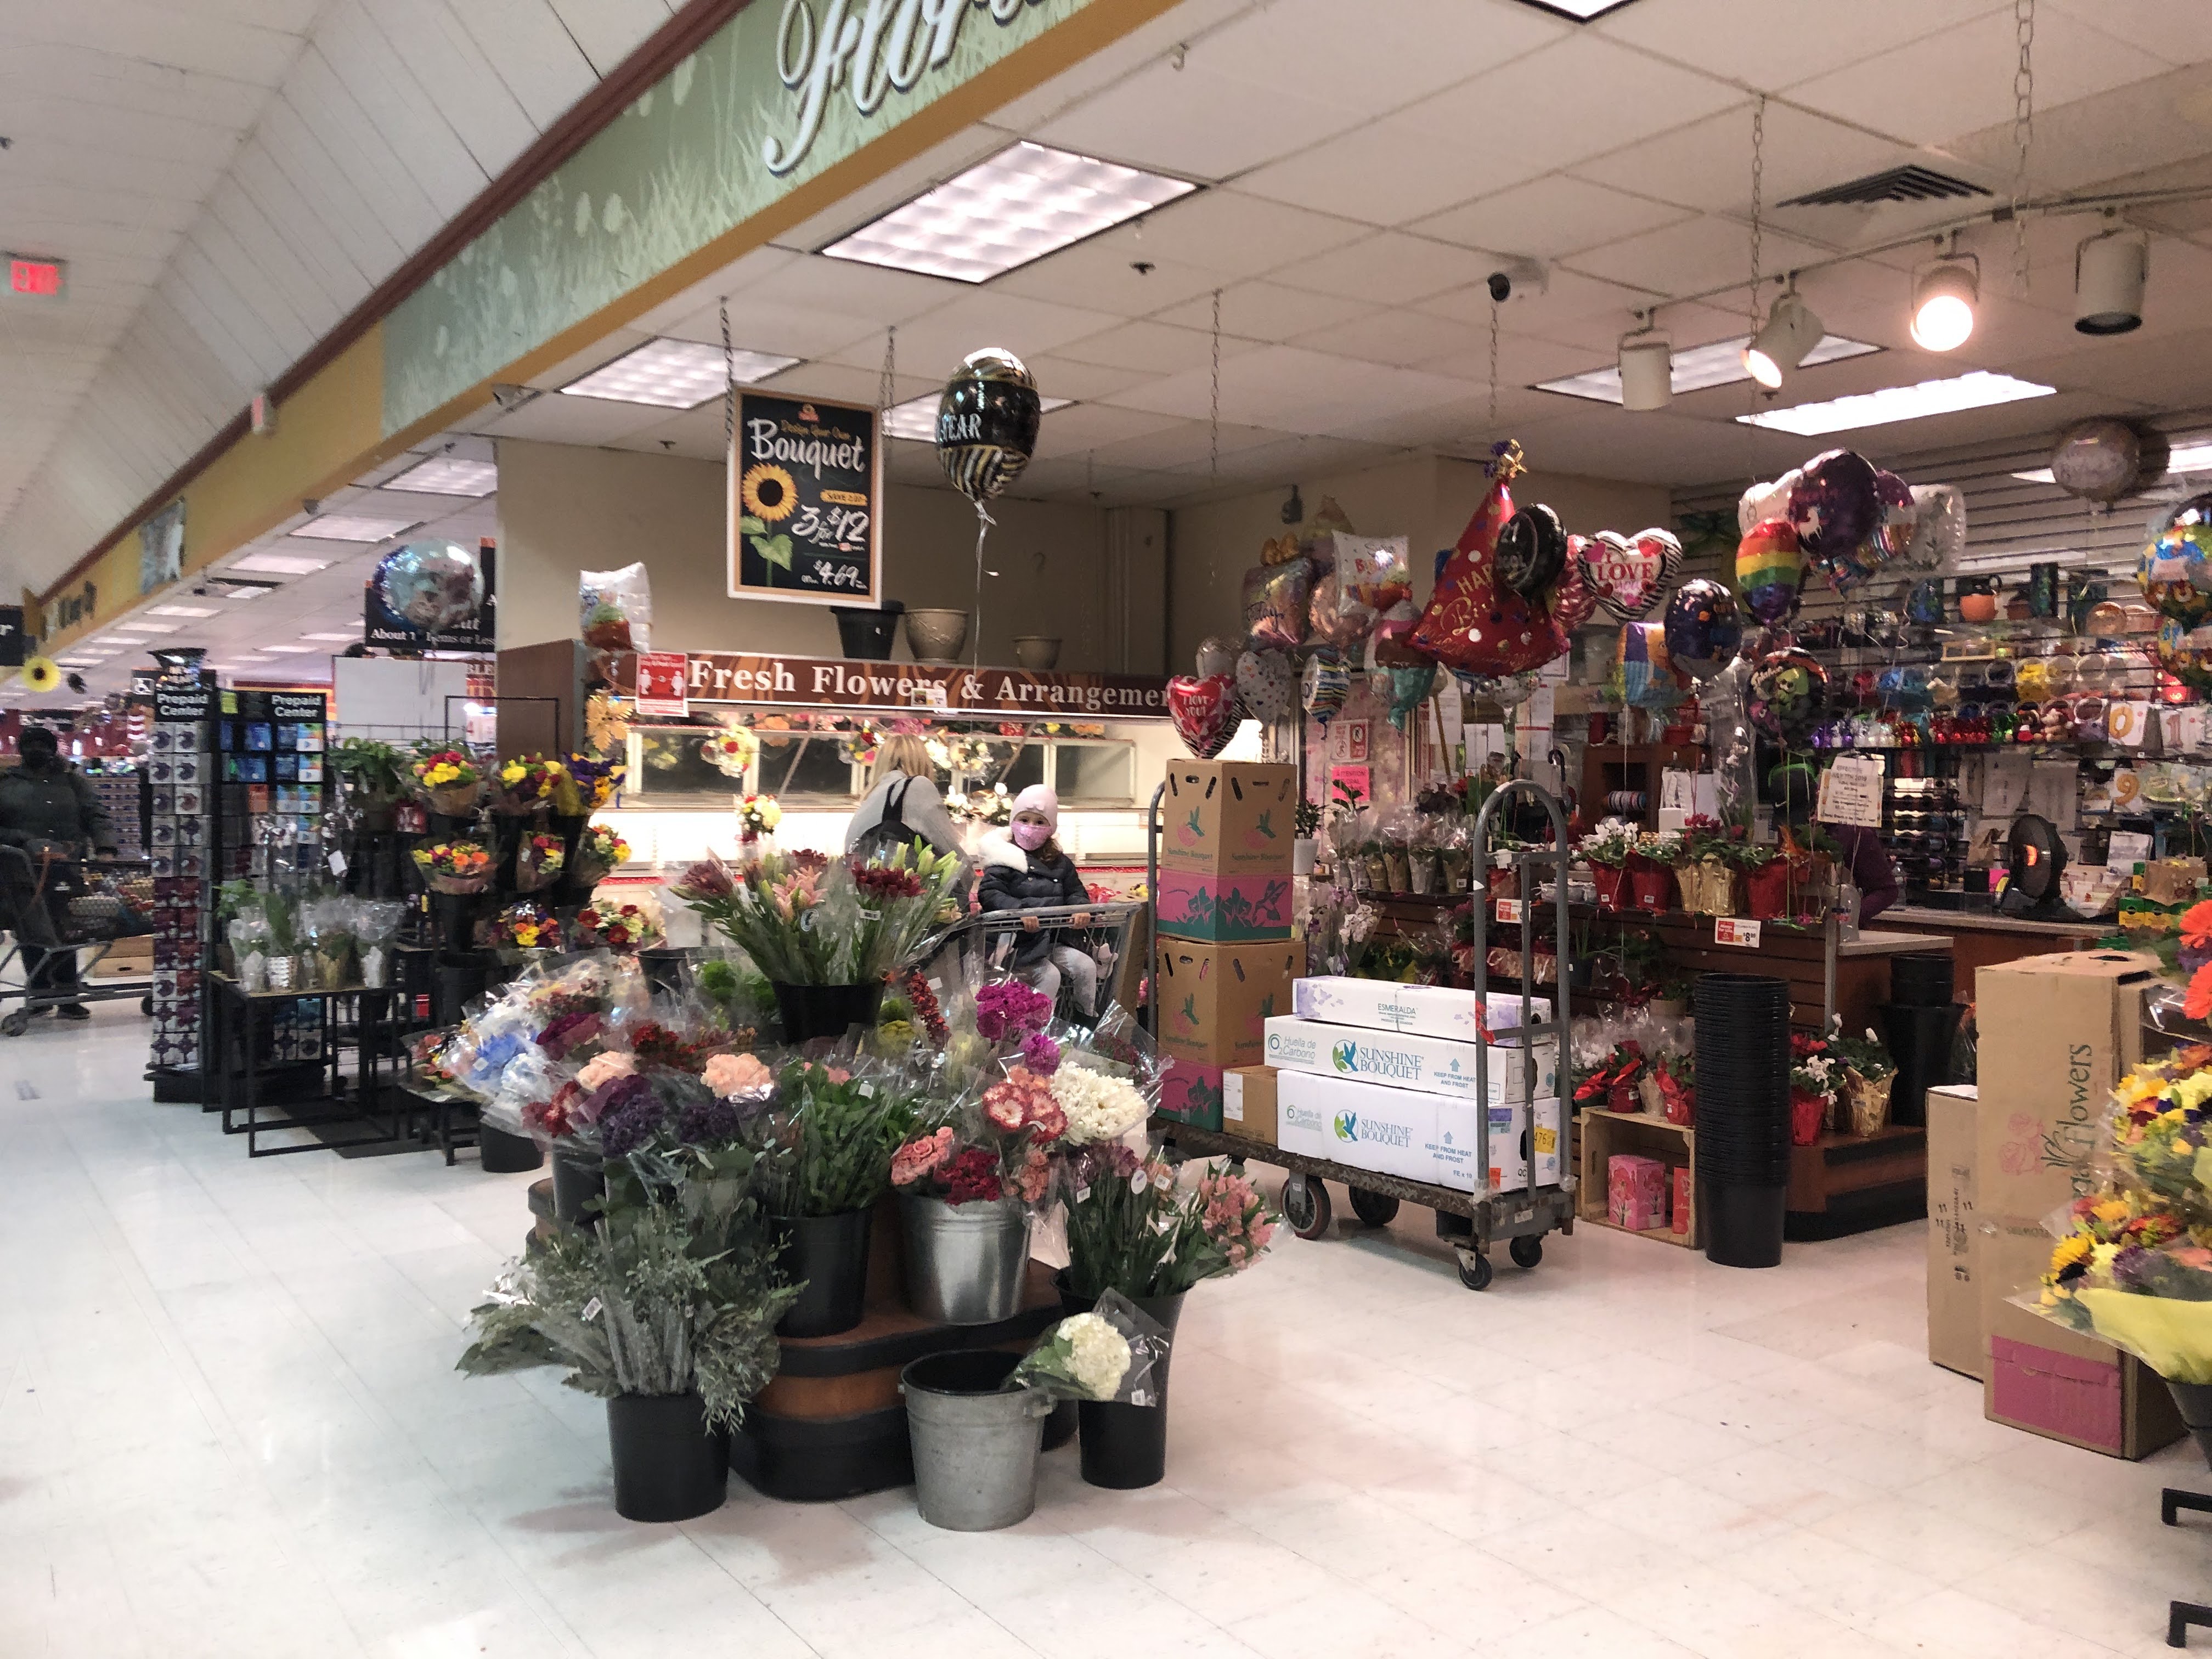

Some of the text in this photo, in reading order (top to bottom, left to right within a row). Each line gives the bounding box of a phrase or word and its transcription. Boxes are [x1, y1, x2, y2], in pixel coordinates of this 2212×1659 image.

[764, 0, 1045, 174] Flor
[747, 417, 866, 481] Bouquet
[792, 504, 821, 536] 3
[827, 506, 869, 543] $12
[1456, 562, 1493, 595] HAP
[1597, 562, 1654, 581] LOVE
[370, 628, 407, 641] About
[688, 660, 1167, 711] Fresh Flowers & Arrangeme
[157, 693, 208, 705] Prepaid
[272, 695, 323, 707] Prepaid
[160, 705, 205, 715] Center
[274, 706, 319, 717] Center
[1378, 1003, 1416, 1014] ESMERALDA
[1284, 1036, 1316, 1049] Huella de
[1283, 1045, 1316, 1059] Carbono
[1360, 1047, 1421, 1068] SUNSHINE
[1361, 1060, 1421, 1080] BOUQUET
[2055, 1043, 2097, 1149] Flowers
[1361, 1119, 1413, 1136] SUNSHINE
[1362, 1130, 1411, 1148] BOUQUET
[1445, 1155, 1464, 1163] FROST
